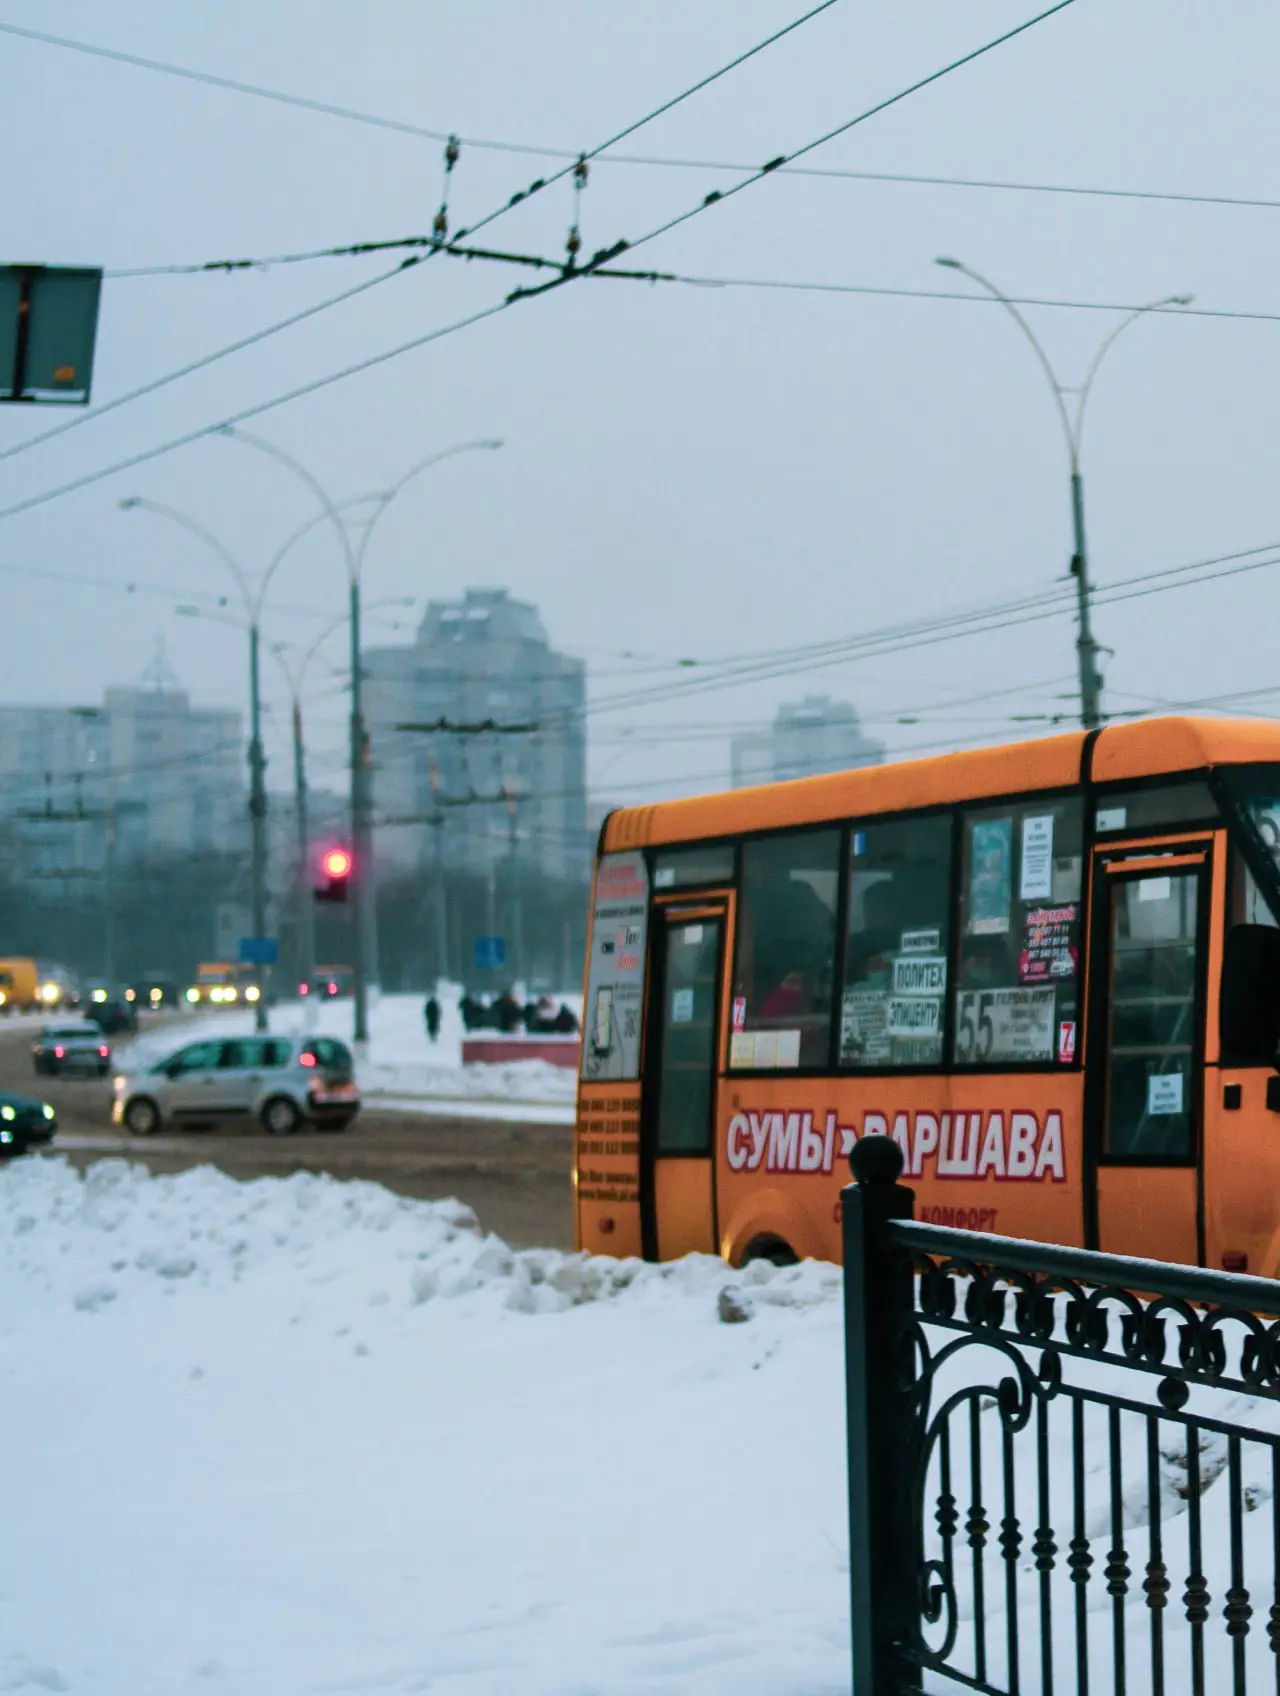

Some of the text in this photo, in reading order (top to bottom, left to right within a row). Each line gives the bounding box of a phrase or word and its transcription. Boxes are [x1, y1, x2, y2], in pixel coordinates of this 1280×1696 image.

[897, 963, 945, 989] ПОЛИТЕХ
[957, 993, 993, 1061] 55
[726, 1112, 836, 1173] СУМЫ
[921, 1207, 998, 1230] КОМФОРТ
